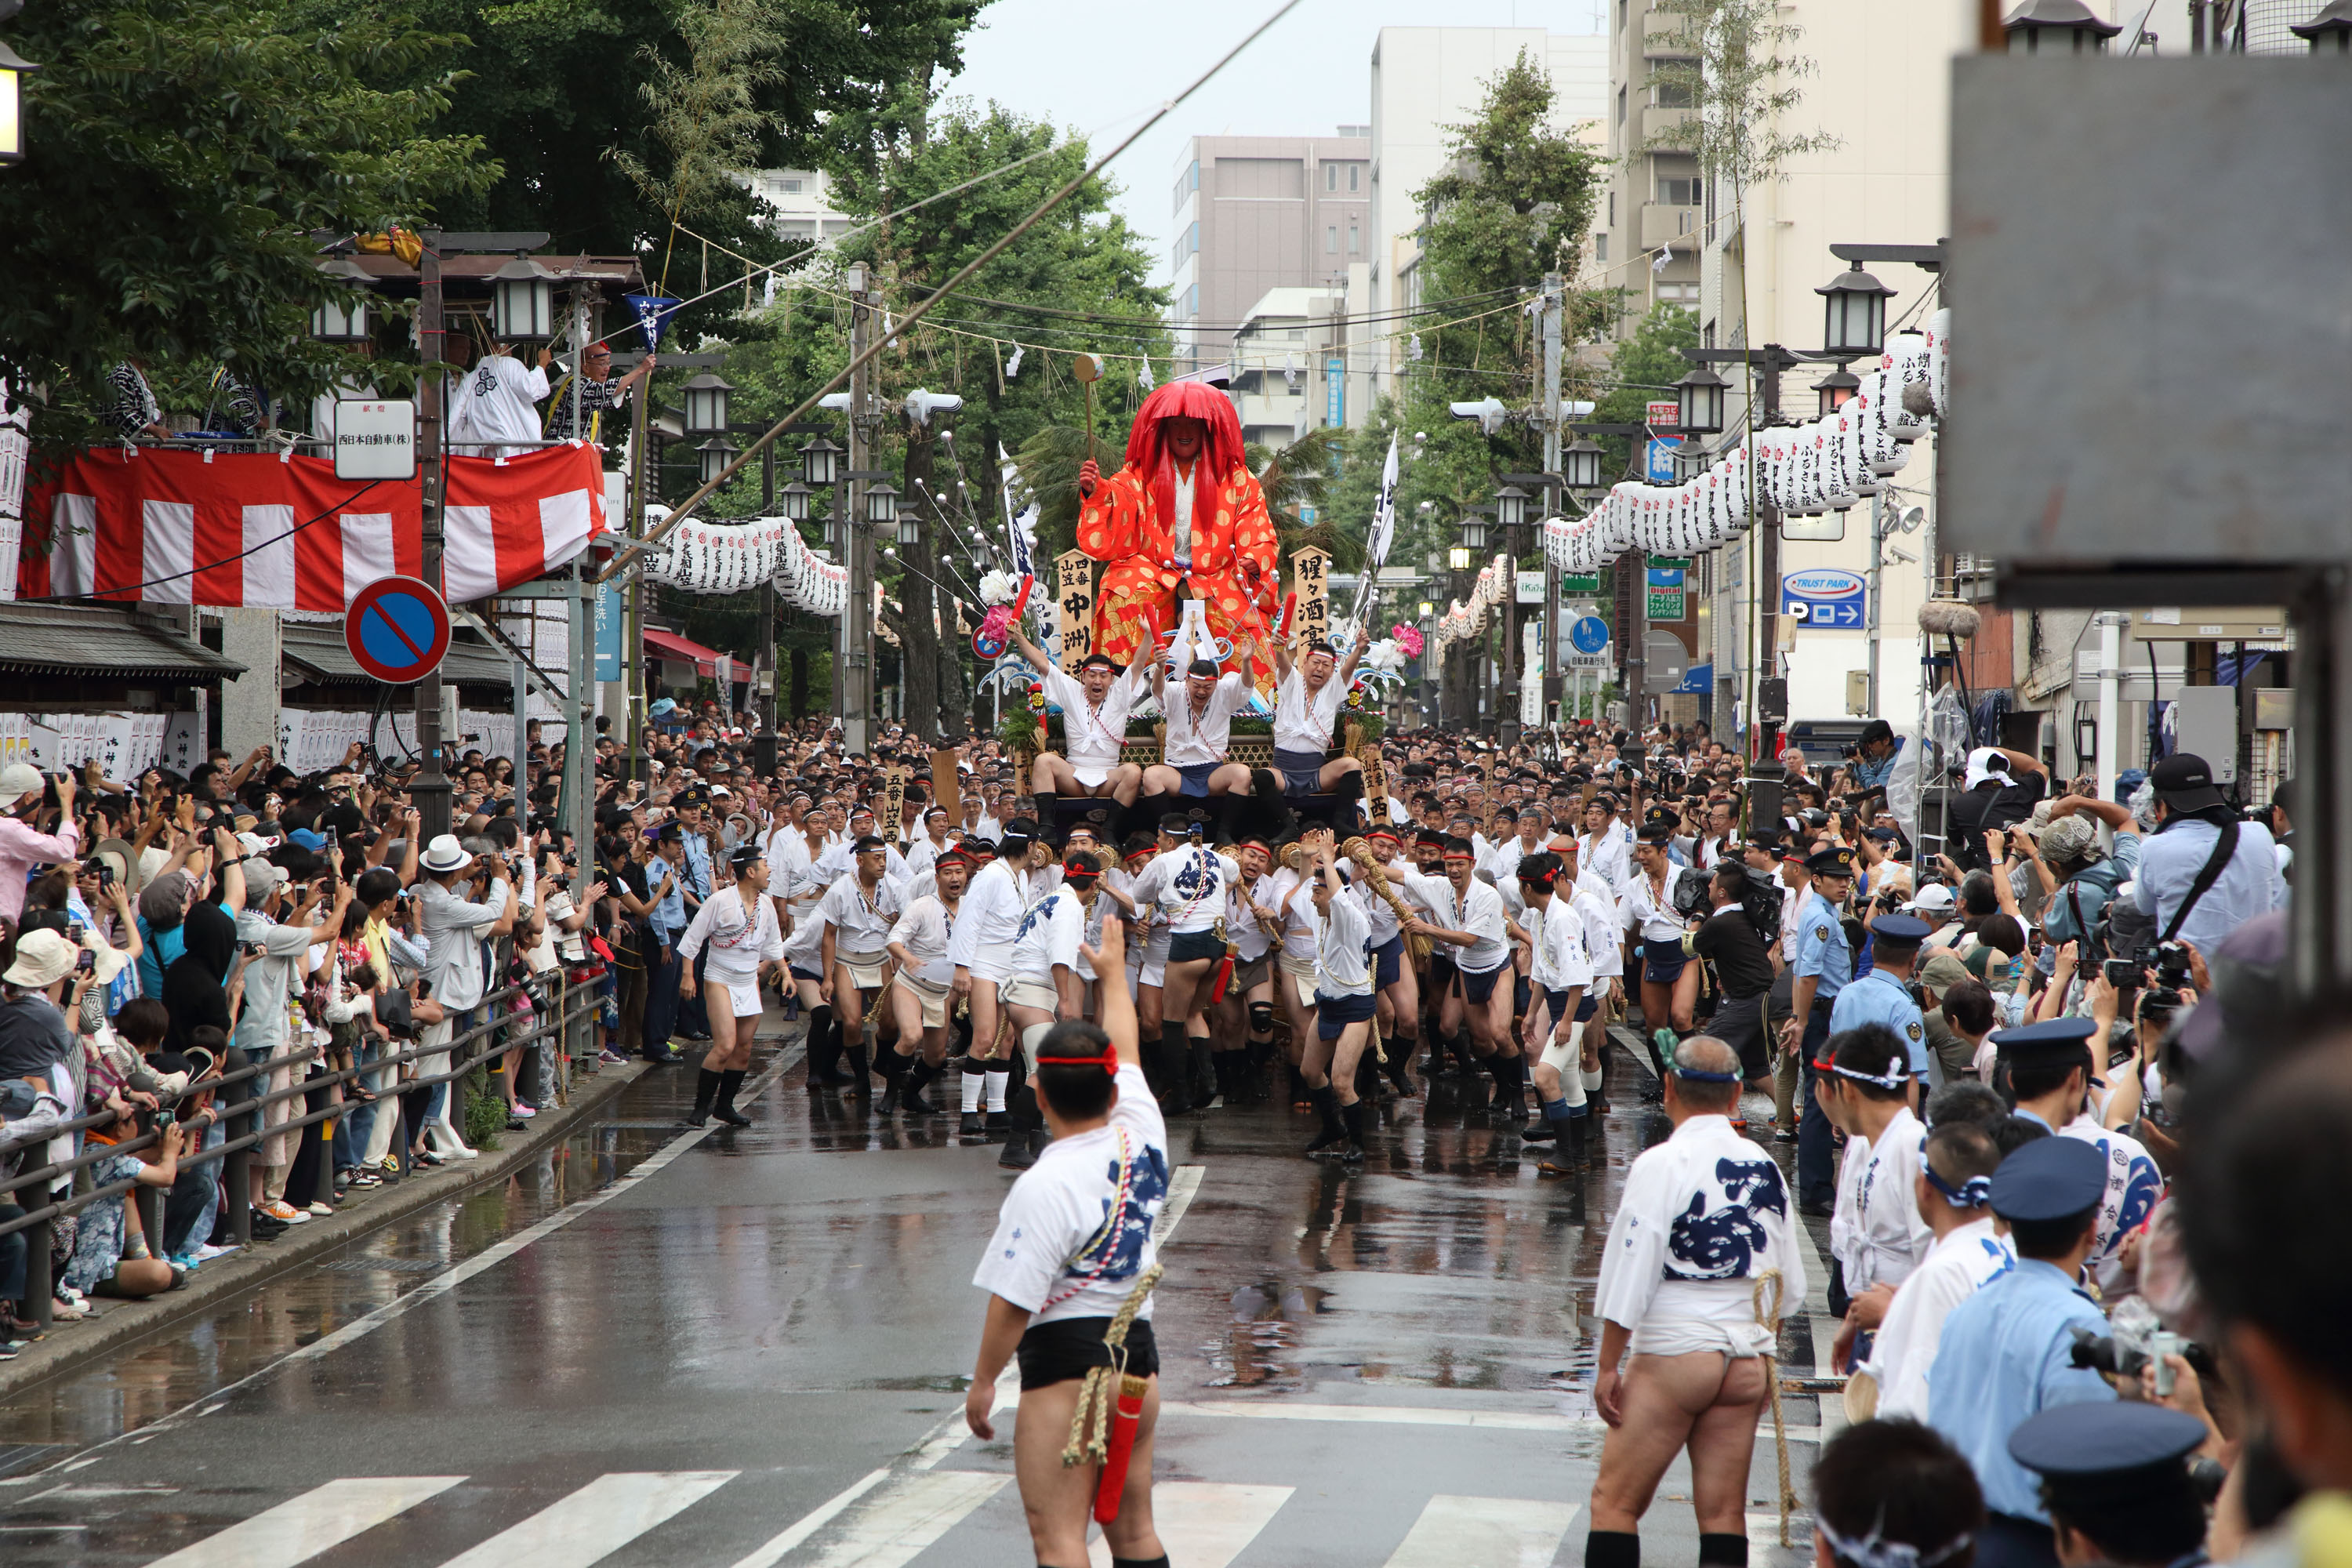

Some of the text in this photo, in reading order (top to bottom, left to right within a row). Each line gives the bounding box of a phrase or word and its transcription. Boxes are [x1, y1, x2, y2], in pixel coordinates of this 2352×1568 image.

[339, 434, 410, 445] 西日本自動車(株)
[1061, 560, 1075, 586] 山笠
[1075, 558, 1091, 586] 四番
[1796, 579, 1851, 588] TRUST PARK
[1650, 586, 1681, 595] Digital
[596, 583, 607, 632] お手洗い
[1572, 657, 1606, 666] 自転車通行可
[1363, 760, 1374, 789] 山笠
[1372, 759, 1385, 786] 五番
[883, 774, 903, 843] 五番山笠西
[1370, 796, 1388, 818] 西
